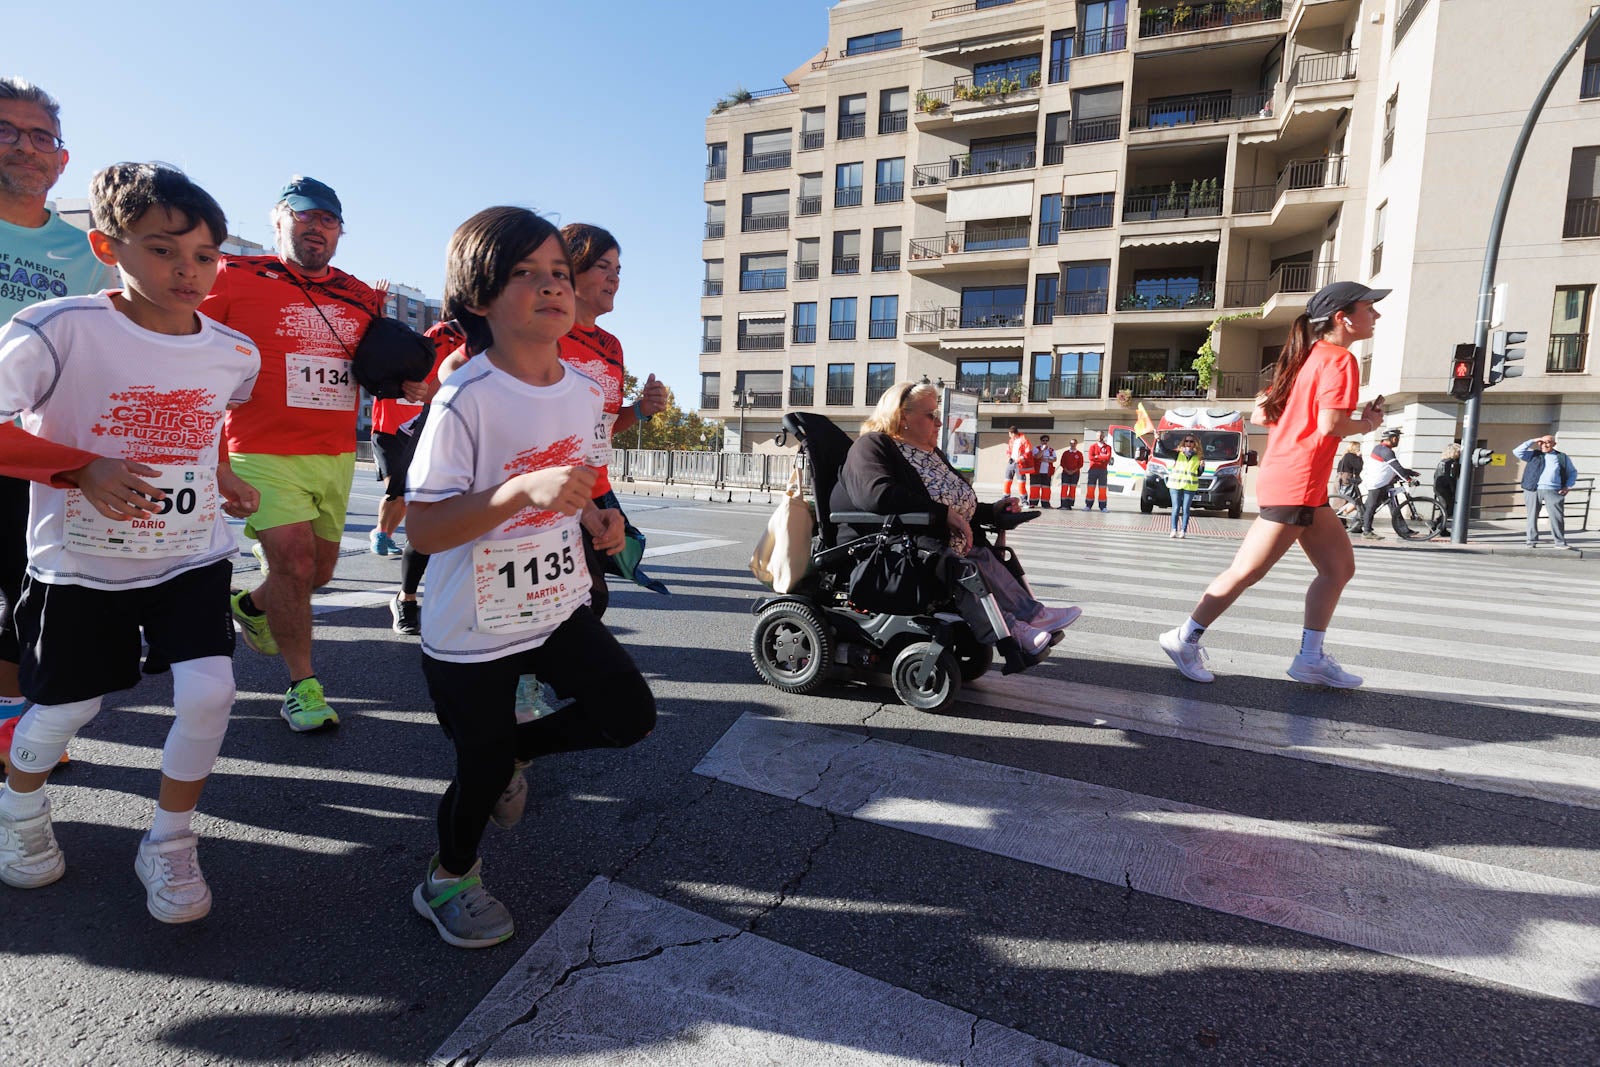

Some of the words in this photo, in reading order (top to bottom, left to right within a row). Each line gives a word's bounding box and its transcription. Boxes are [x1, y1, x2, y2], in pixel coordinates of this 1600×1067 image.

[14, 257, 66, 281] AMERICA
[1, 282, 47, 301] ATHON
[301, 366, 349, 386] 1134
[112, 405, 216, 430] carrera
[110, 425, 216, 446] cruzroja.es
[132, 518, 166, 530] DARÍO
[498, 545, 575, 589] 1135
